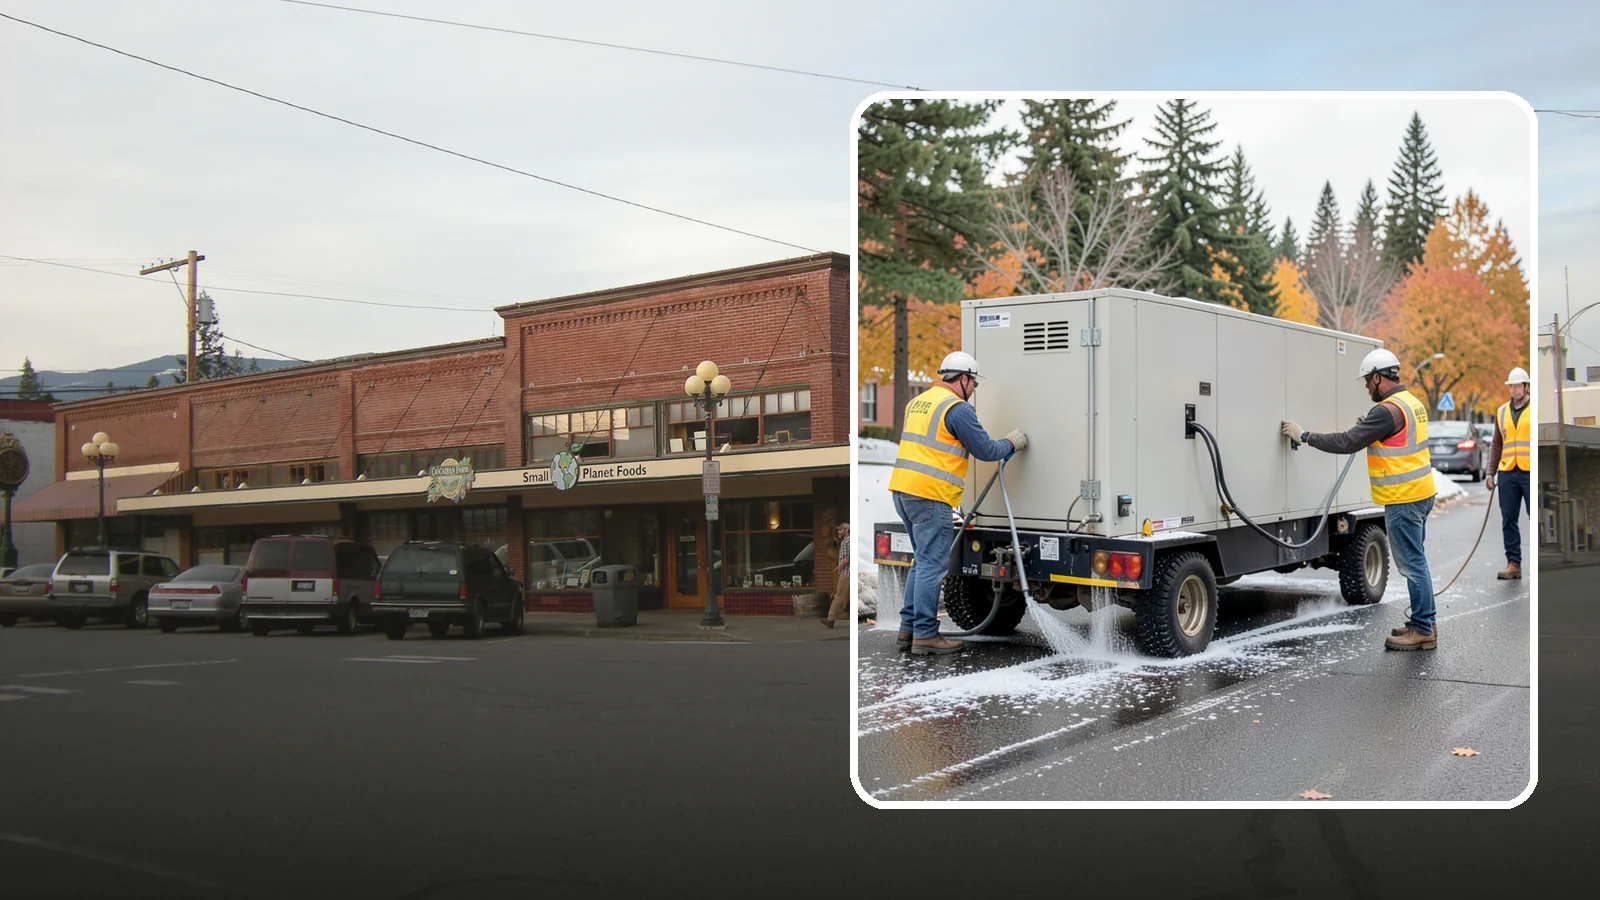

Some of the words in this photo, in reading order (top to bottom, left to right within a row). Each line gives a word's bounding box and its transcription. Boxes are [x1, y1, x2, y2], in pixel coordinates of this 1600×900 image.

[523, 471, 549, 483] Small
[583, 467, 614, 479] Planet
[616, 464, 647, 477] Foods
